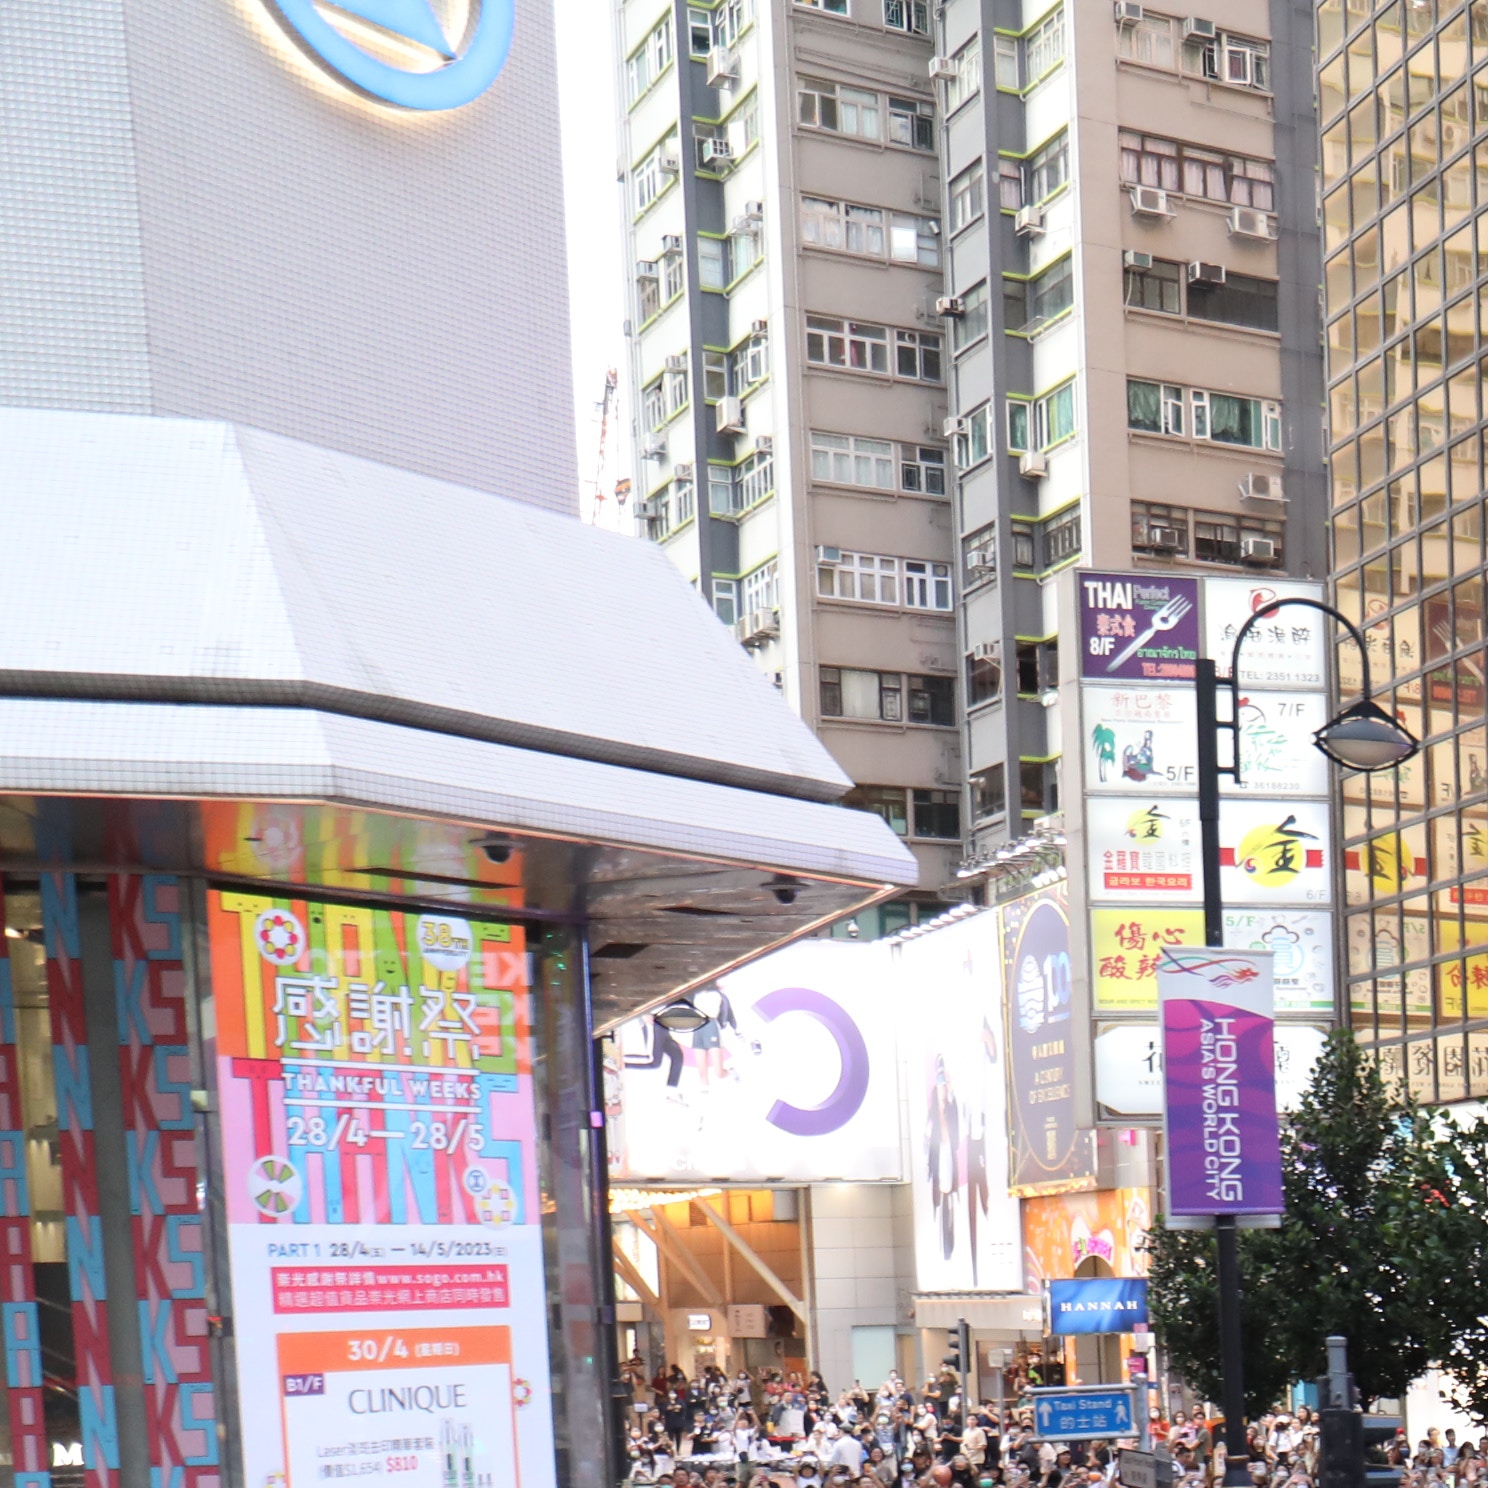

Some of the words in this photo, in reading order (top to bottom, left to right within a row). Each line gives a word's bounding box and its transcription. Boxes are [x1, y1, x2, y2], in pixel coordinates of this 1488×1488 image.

[1083, 580, 1133, 611] THAI
[1089, 636, 1116, 656] 8/F
[1277, 702, 1305, 718] 7/F
[1165, 765, 1195, 782] 5/F
[1114, 920, 1186, 948] 傷心
[272, 974, 481, 1062] 感謝祭
[1200, 1018, 1217, 1079] ASIA'S
[1213, 1018, 1239, 1111] HONG
[282, 1072, 404, 1097] THANKFUL
[409, 1079, 482, 1100] WEEKS
[1202, 1080, 1218, 1146] WORLD
[1217, 1112, 1243, 1202] KONG
[1204, 1147, 1222, 1201] CITY
[267, 1242, 308, 1258] PART
[1060, 1301, 1139, 1312] HANNAH
[346, 1335, 410, 1363] 30/4
[348, 1383, 468, 1415] CLINIQUE
[1053, 1400, 1077, 1412] Taxi
[1078, 1399, 1113, 1410] Stand
[1060, 1415, 1108, 1430] 的士站
